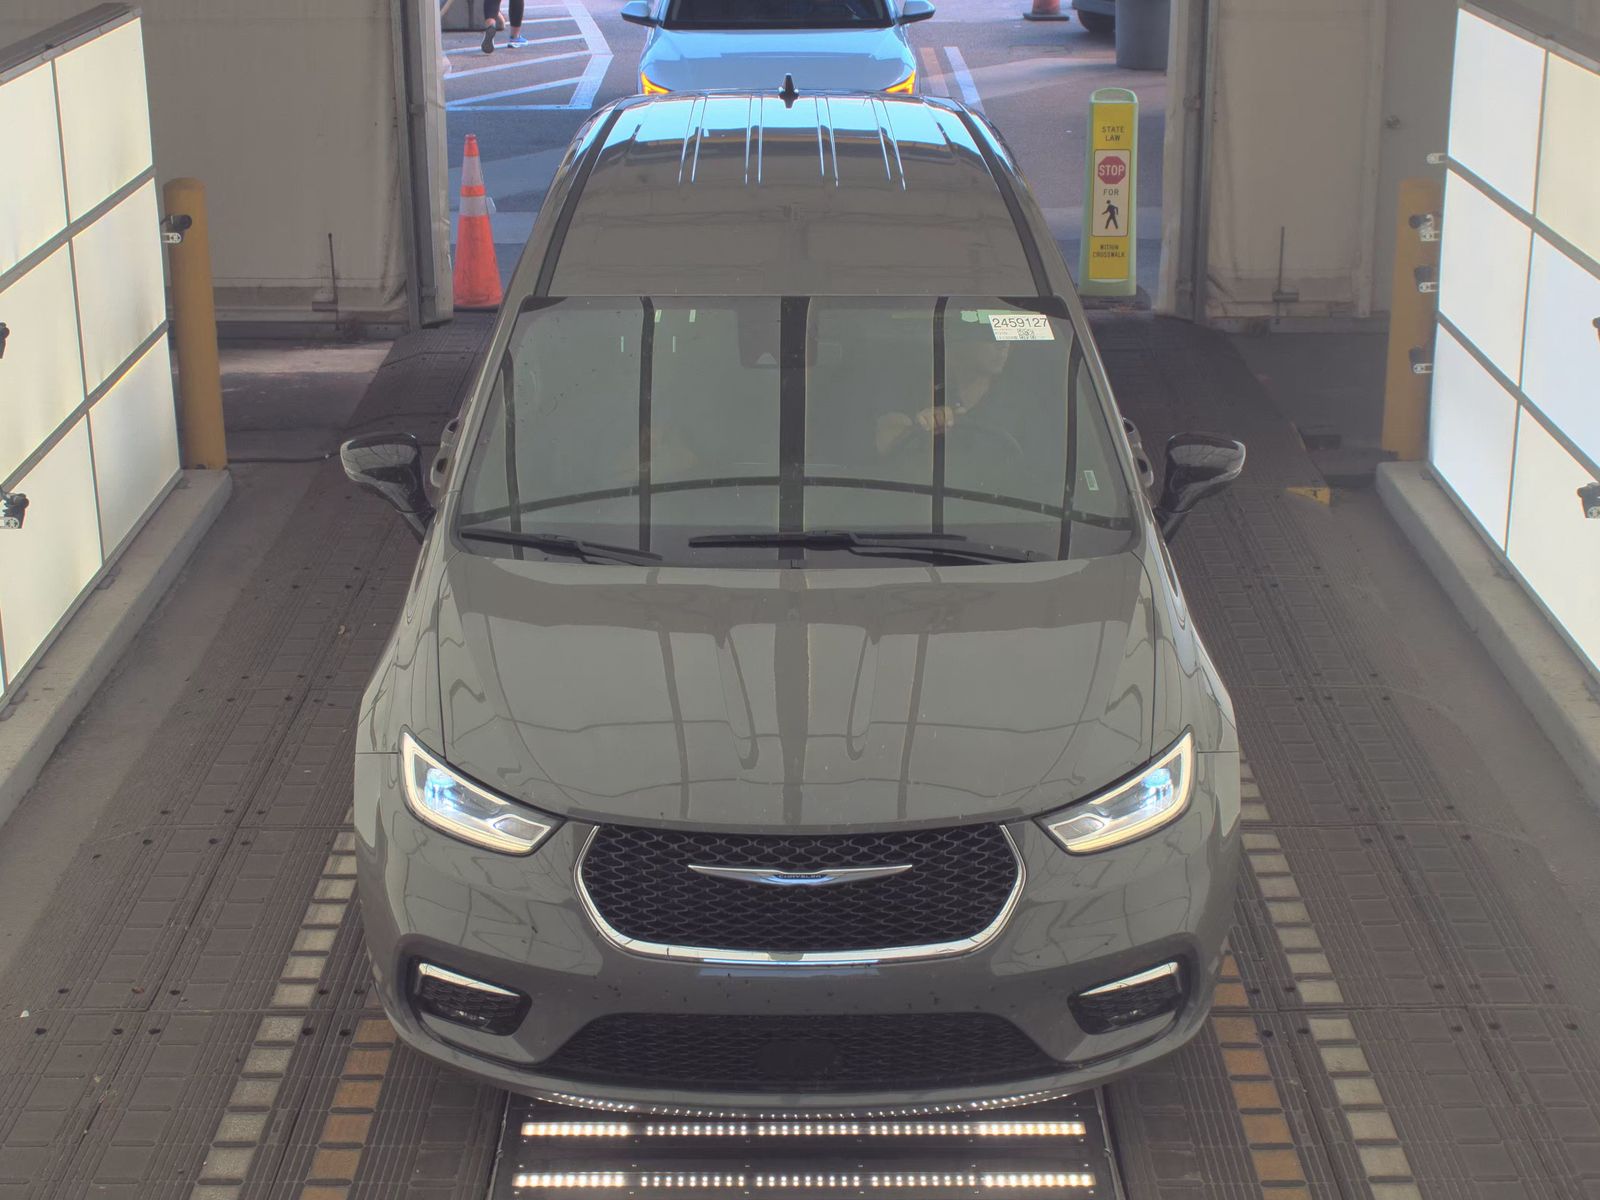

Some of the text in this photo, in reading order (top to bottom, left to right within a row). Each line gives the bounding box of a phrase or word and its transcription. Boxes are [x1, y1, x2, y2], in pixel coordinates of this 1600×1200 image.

[1099, 164, 1125, 176] STOP
[1103, 188, 1120, 196] FOR
[993, 318, 1047, 328] 2459127
